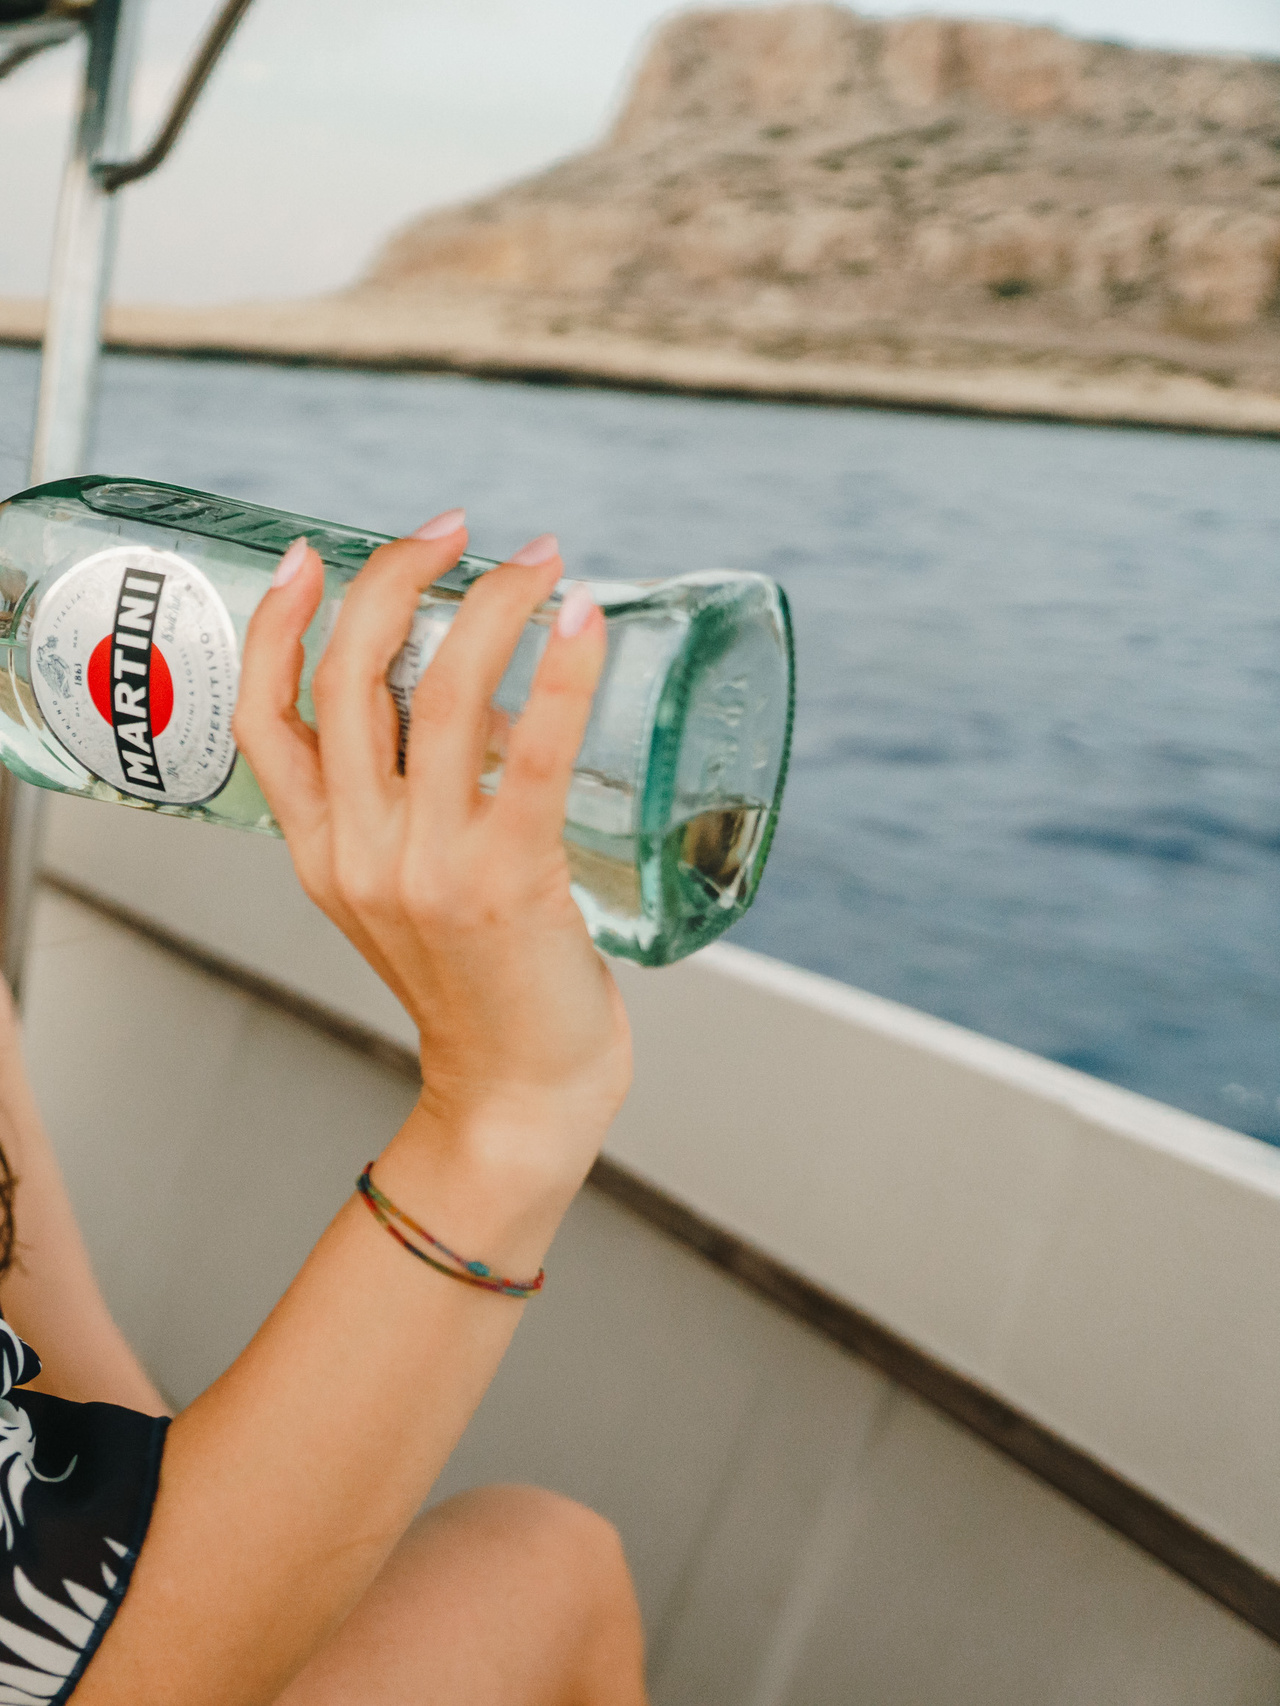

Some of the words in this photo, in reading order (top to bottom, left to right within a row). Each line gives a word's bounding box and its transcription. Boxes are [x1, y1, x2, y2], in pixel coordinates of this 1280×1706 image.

[73, 663, 82, 686] 1863
[114, 574, 163, 785] MARTINI
[52, 700, 83, 747] TORINO
